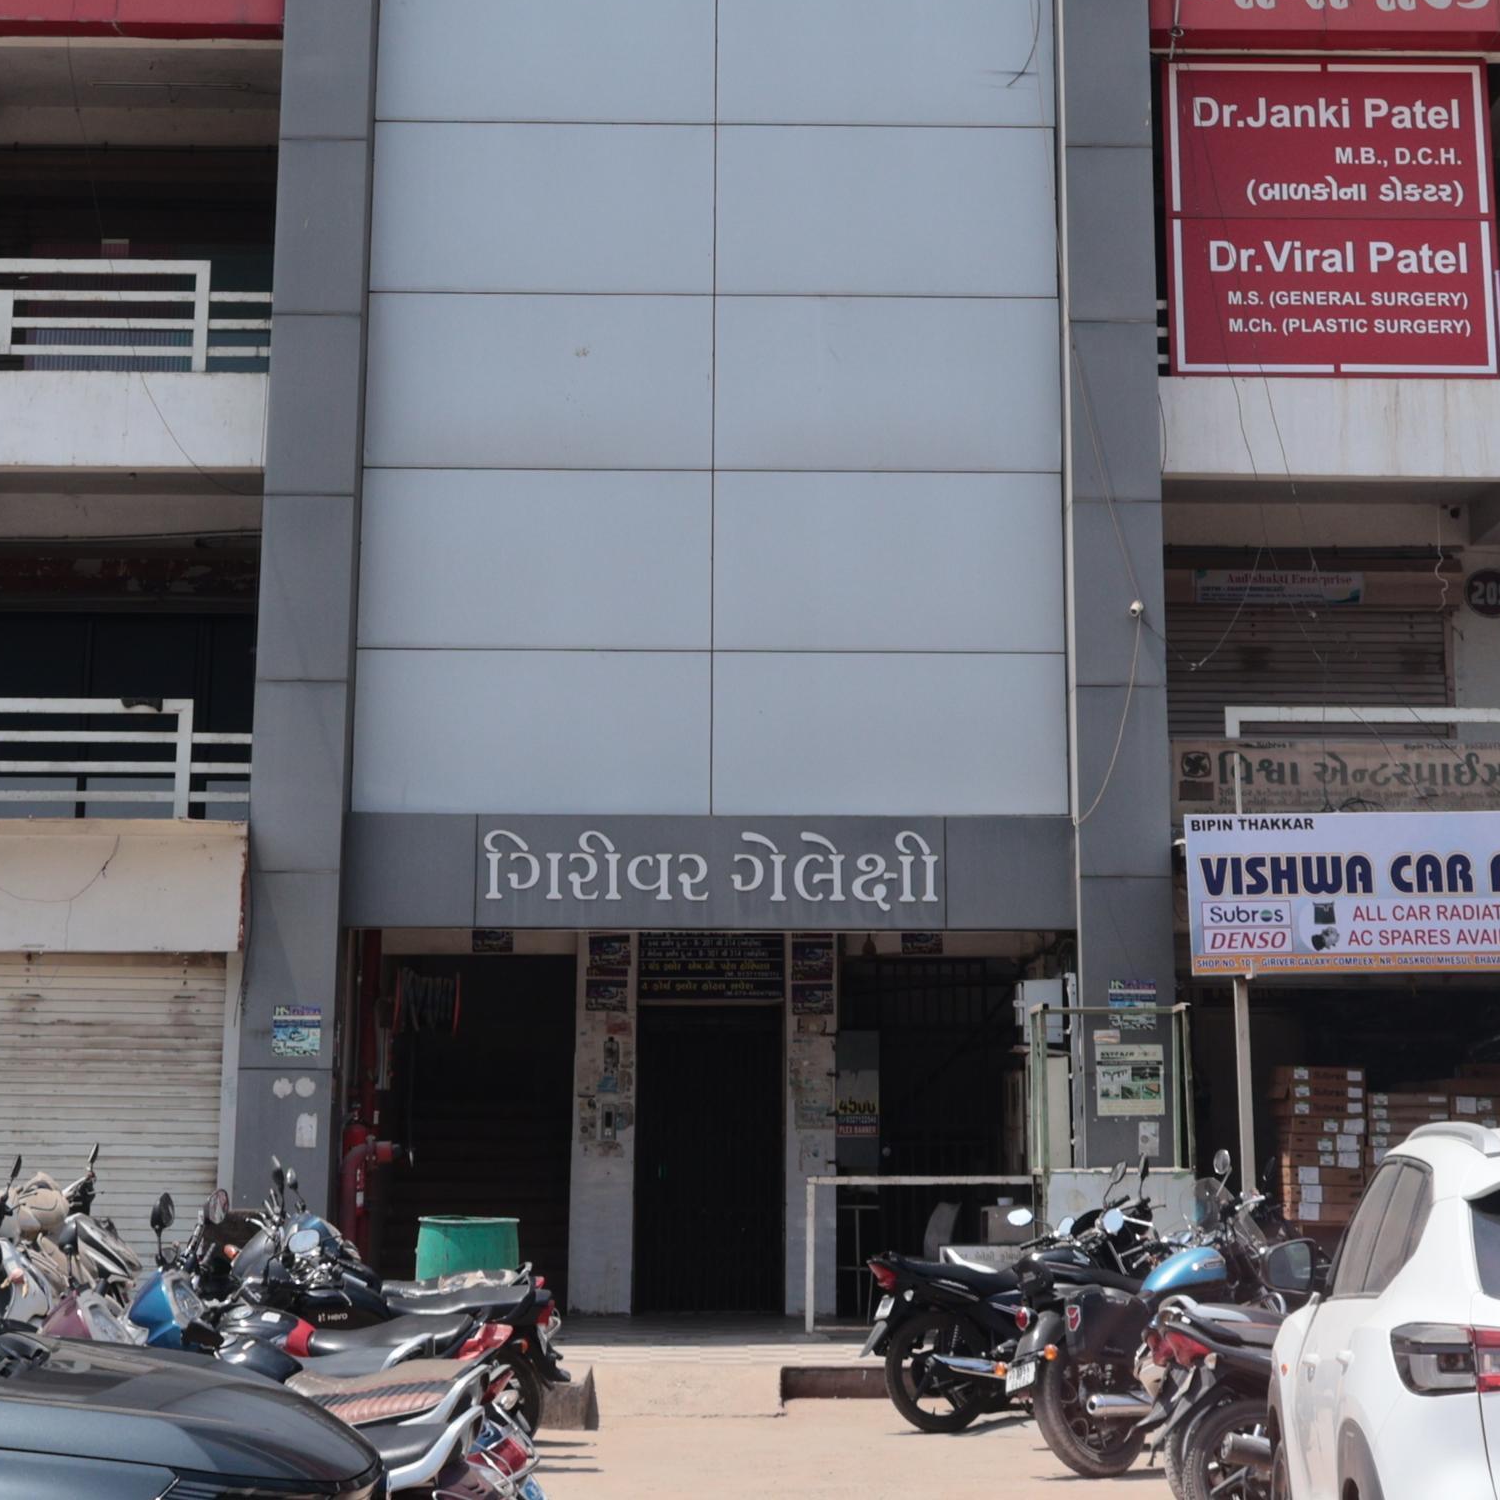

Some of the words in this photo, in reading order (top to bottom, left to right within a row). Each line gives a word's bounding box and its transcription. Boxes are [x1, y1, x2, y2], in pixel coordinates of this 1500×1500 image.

[1192, 96, 1351, 129] Dr.Janki
[1363, 98, 1461, 130] Patel
[1335, 147, 1389, 168] M.B.,
[1394, 147, 1462, 165] D.C.H.
[1246, 175, 1368, 206] (બાળકોના
[1209, 240, 1355, 274] Dr.Viral
[1368, 241, 1469, 274] Patel
[1228, 290, 1264, 306] M.S.
[1269, 290, 1366, 308] (GENERAL
[1371, 291, 1469, 309] SURGERY)
[1228, 317, 1277, 334] M.Ch.
[1282, 317, 1369, 335] (PLASTIC
[1373, 318, 1471, 336] SURGERY)
[1190, 819, 1234, 833] BIPIN
[1237, 817, 1315, 832] THAKKAR
[484, 829, 710, 902] ગિરીવર
[1200, 853, 1375, 897] VISHWA
[1389, 852, 1474, 895] CAR
[1209, 906, 1285, 923] Subros
[1352, 904, 1388, 922] ALL
[1391, 904, 1434, 921] CAR
[1210, 930, 1287, 950] DENSO
[1347, 929, 1374, 946] AC
[1378, 929, 1451, 946] SPARES
